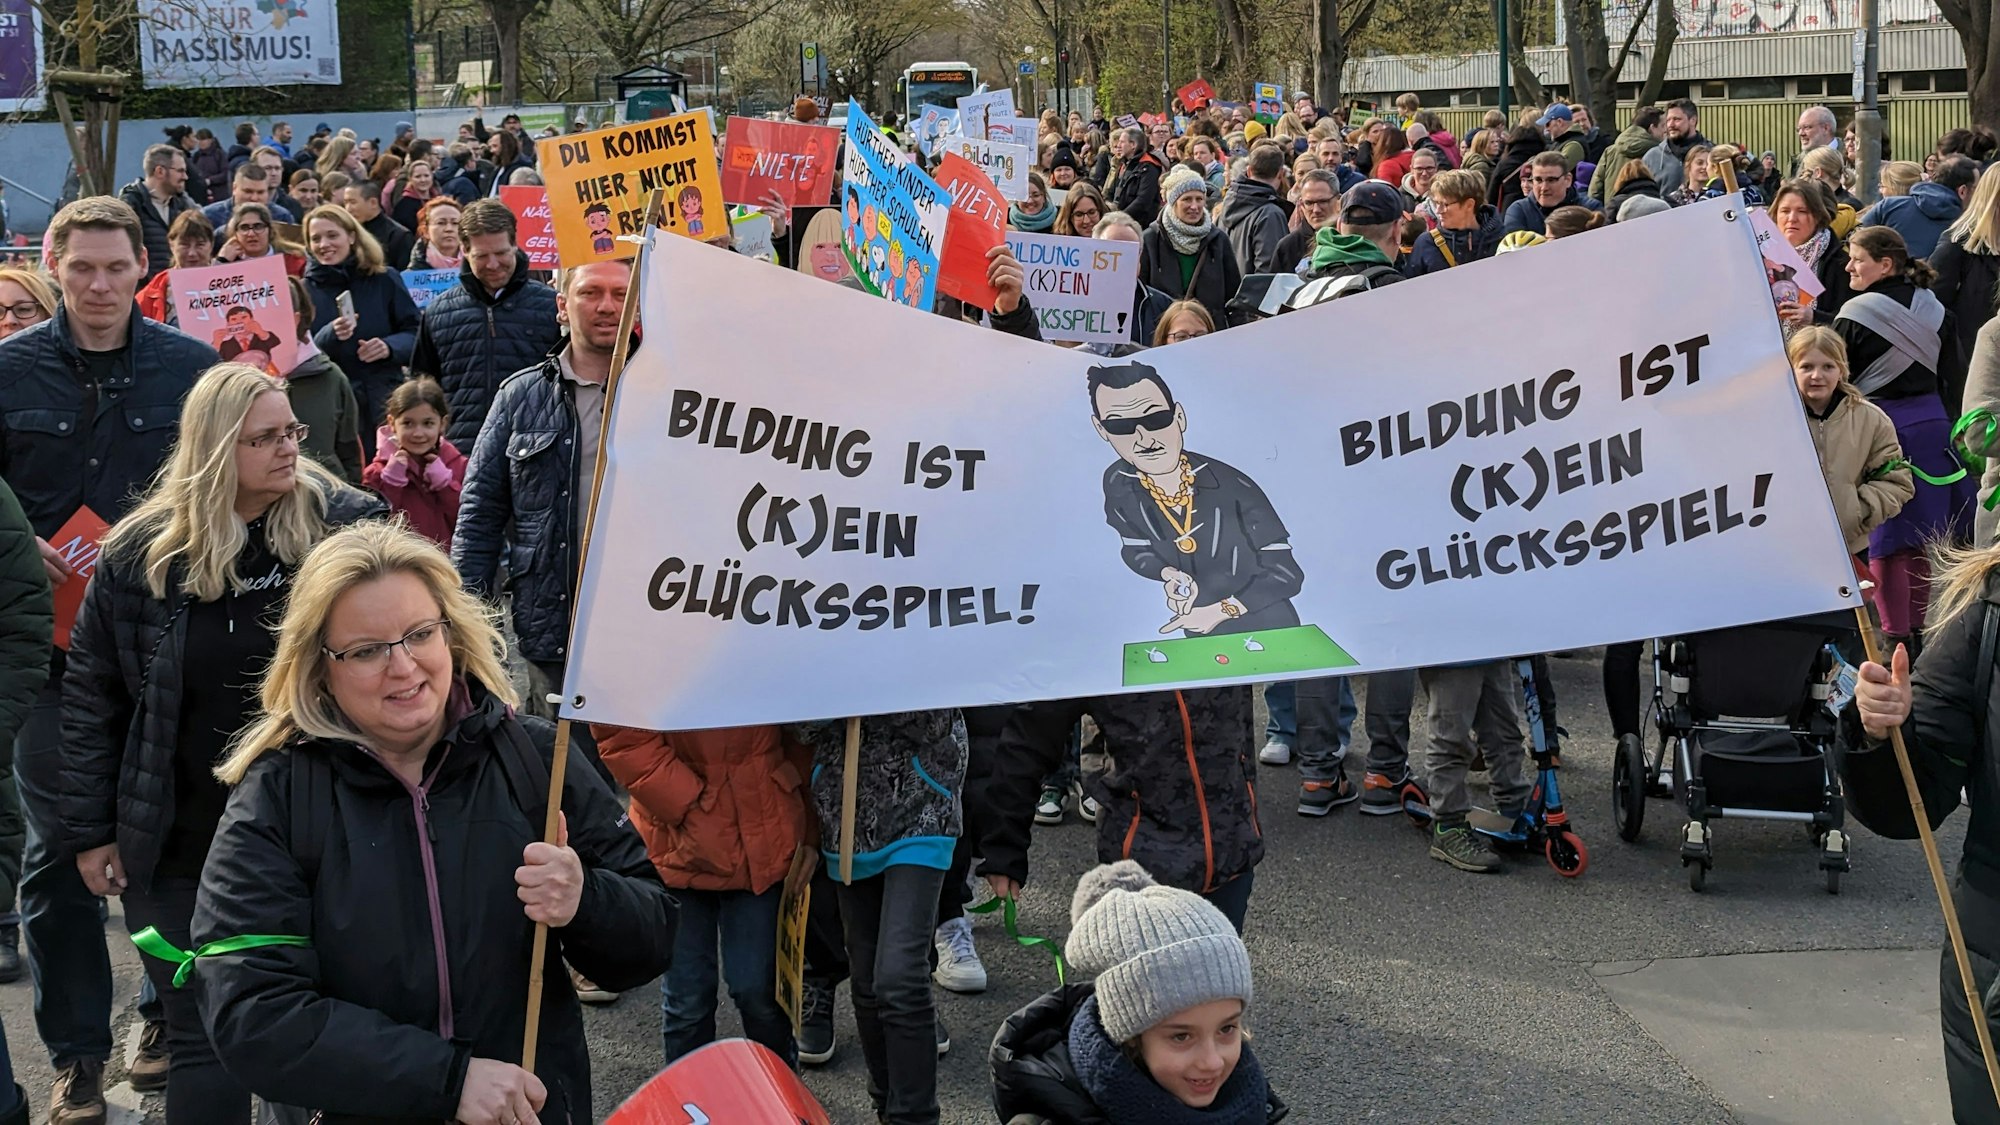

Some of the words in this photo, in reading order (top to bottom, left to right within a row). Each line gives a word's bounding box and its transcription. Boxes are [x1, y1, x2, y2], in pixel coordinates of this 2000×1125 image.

[150, 7, 196, 31] ORT
[208, 1, 254, 31] FÜR
[153, 36, 311, 63] RASSISMUS!
[559, 140, 590, 168] DU
[602, 119, 696, 159] KOMMST
[749, 152, 815, 181] NIETE
[855, 118, 896, 175] HÜRTHER
[895, 162, 935, 214] KINDER
[575, 172, 628, 204] HIER
[639, 158, 697, 193] NICHT
[849, 149, 888, 208] HÜRTHER
[887, 196, 934, 254] SCHULEN
[946, 178, 1003, 231] NIETE
[617, 202, 676, 235] REN!
[1029, 268, 1091, 296] (K)EIN
[1092, 250, 1122, 272] IST
[189, 285, 275, 310] KINDERLOTTERIE
[1339, 368, 1581, 467] BILDUNG
[1619, 334, 1710, 402] IST
[667, 389, 872, 478] BILDUNG
[903, 441, 986, 492] IST
[1450, 428, 1643, 523] (K)EIN
[736, 482, 918, 559] (K)EIN
[1376, 473, 1774, 590] GLÜCKSSPIEL!
[647, 557, 1040, 631] GLÜCKSSPIEL!
